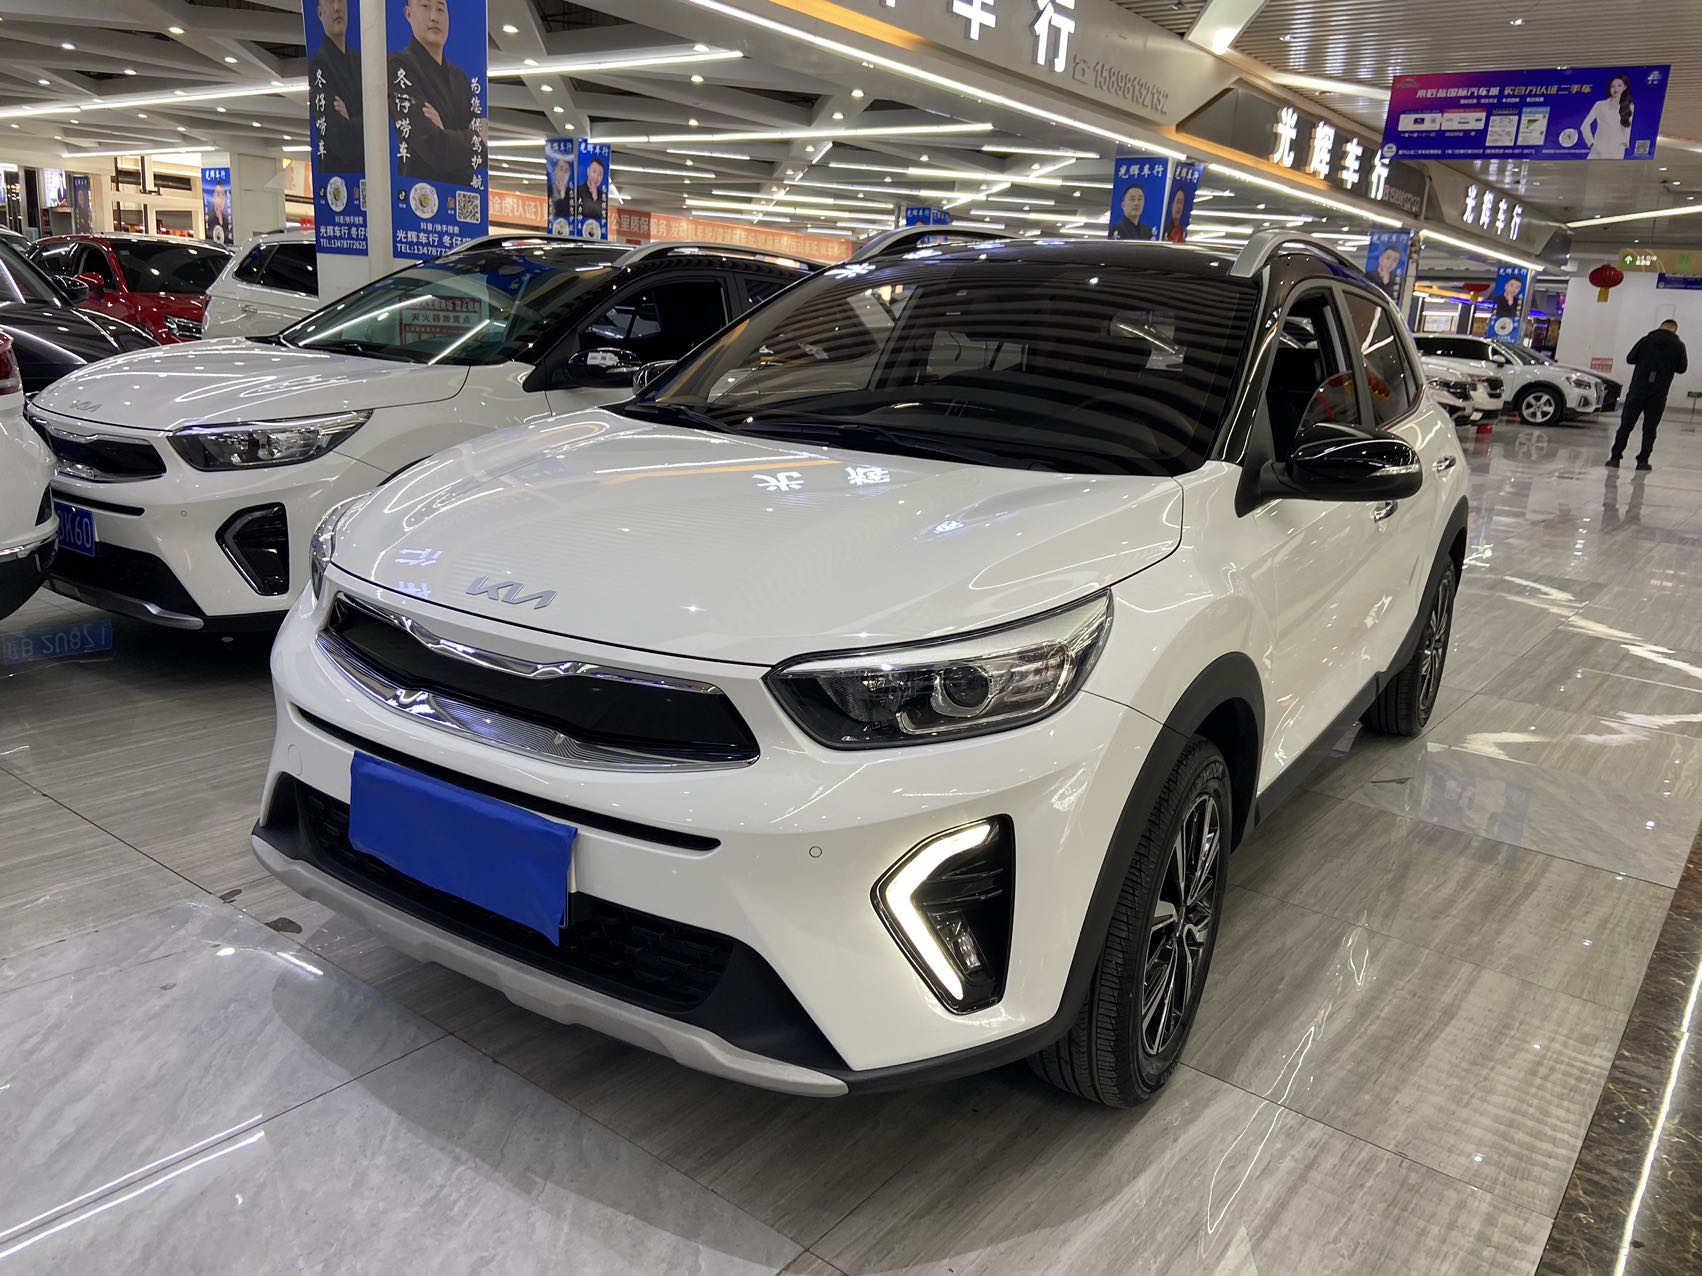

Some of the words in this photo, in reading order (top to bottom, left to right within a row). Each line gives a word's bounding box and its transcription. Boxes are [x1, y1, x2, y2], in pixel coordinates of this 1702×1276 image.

[470, 77, 484, 190] 为您保驾护航
[1271, 105, 1391, 200] 光辉车行
[1118, 164, 1165, 179] 光辉车行
[1463, 184, 1523, 241] 光辉车行
[319, 225, 349, 239] 光辉车行
[351, 226, 368, 240] 冬仔
[396, 229, 439, 246] 光辉车行
[466, 575, 558, 610] KIA
